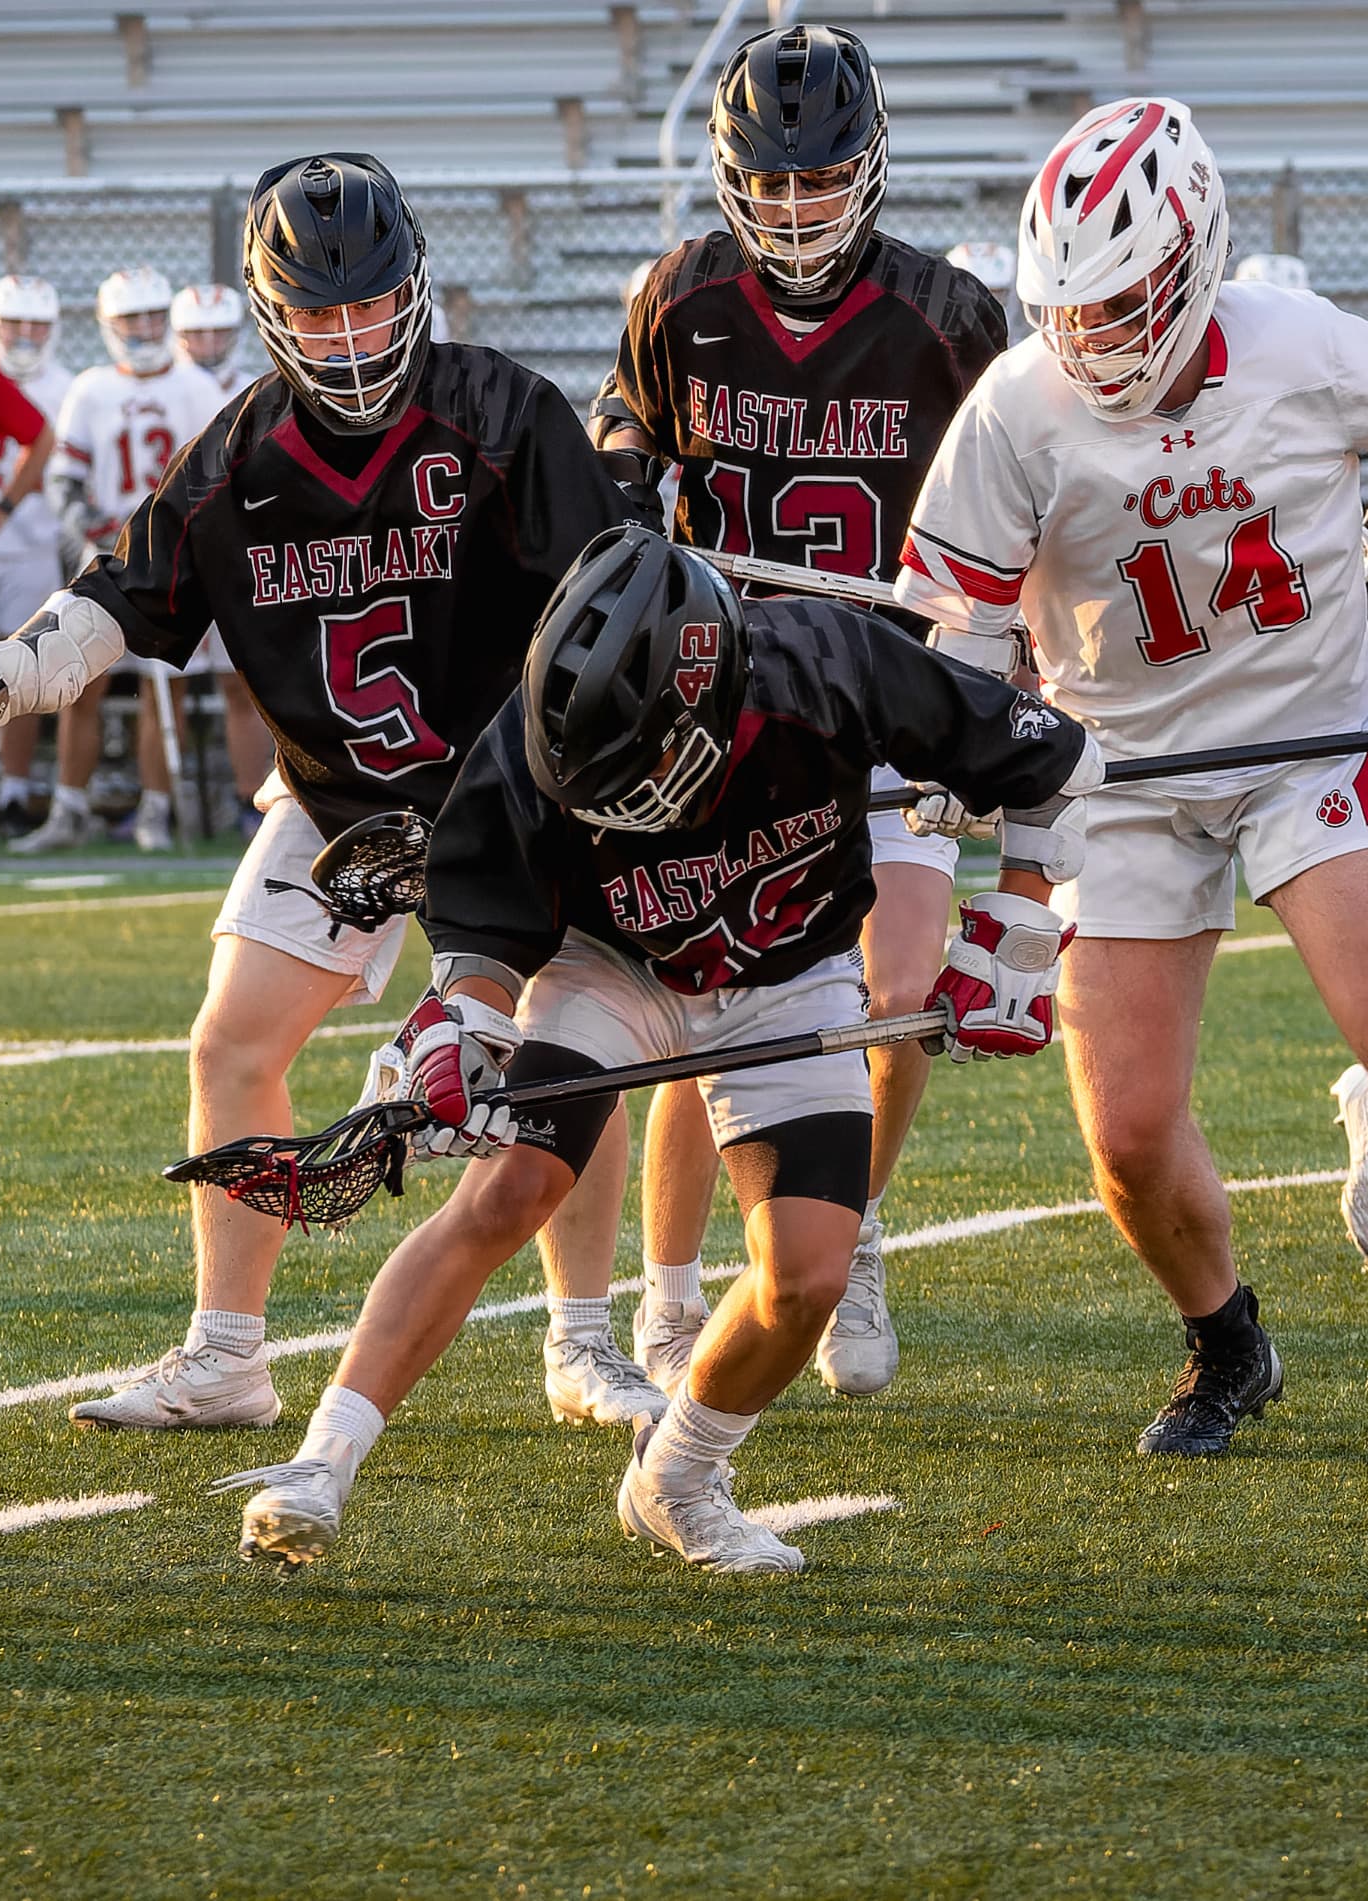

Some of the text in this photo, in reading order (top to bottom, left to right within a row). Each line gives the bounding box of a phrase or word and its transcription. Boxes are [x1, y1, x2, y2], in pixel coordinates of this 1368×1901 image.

[688, 375, 909, 458] EASTLAKE
[412, 452, 466, 520] C
[1123, 465, 1255, 528] 'Cats
[1116, 504, 1312, 667] 14
[318, 595, 455, 781] 5
[674, 622, 721, 707] 42
[600, 799, 842, 933] EASTLAKE
